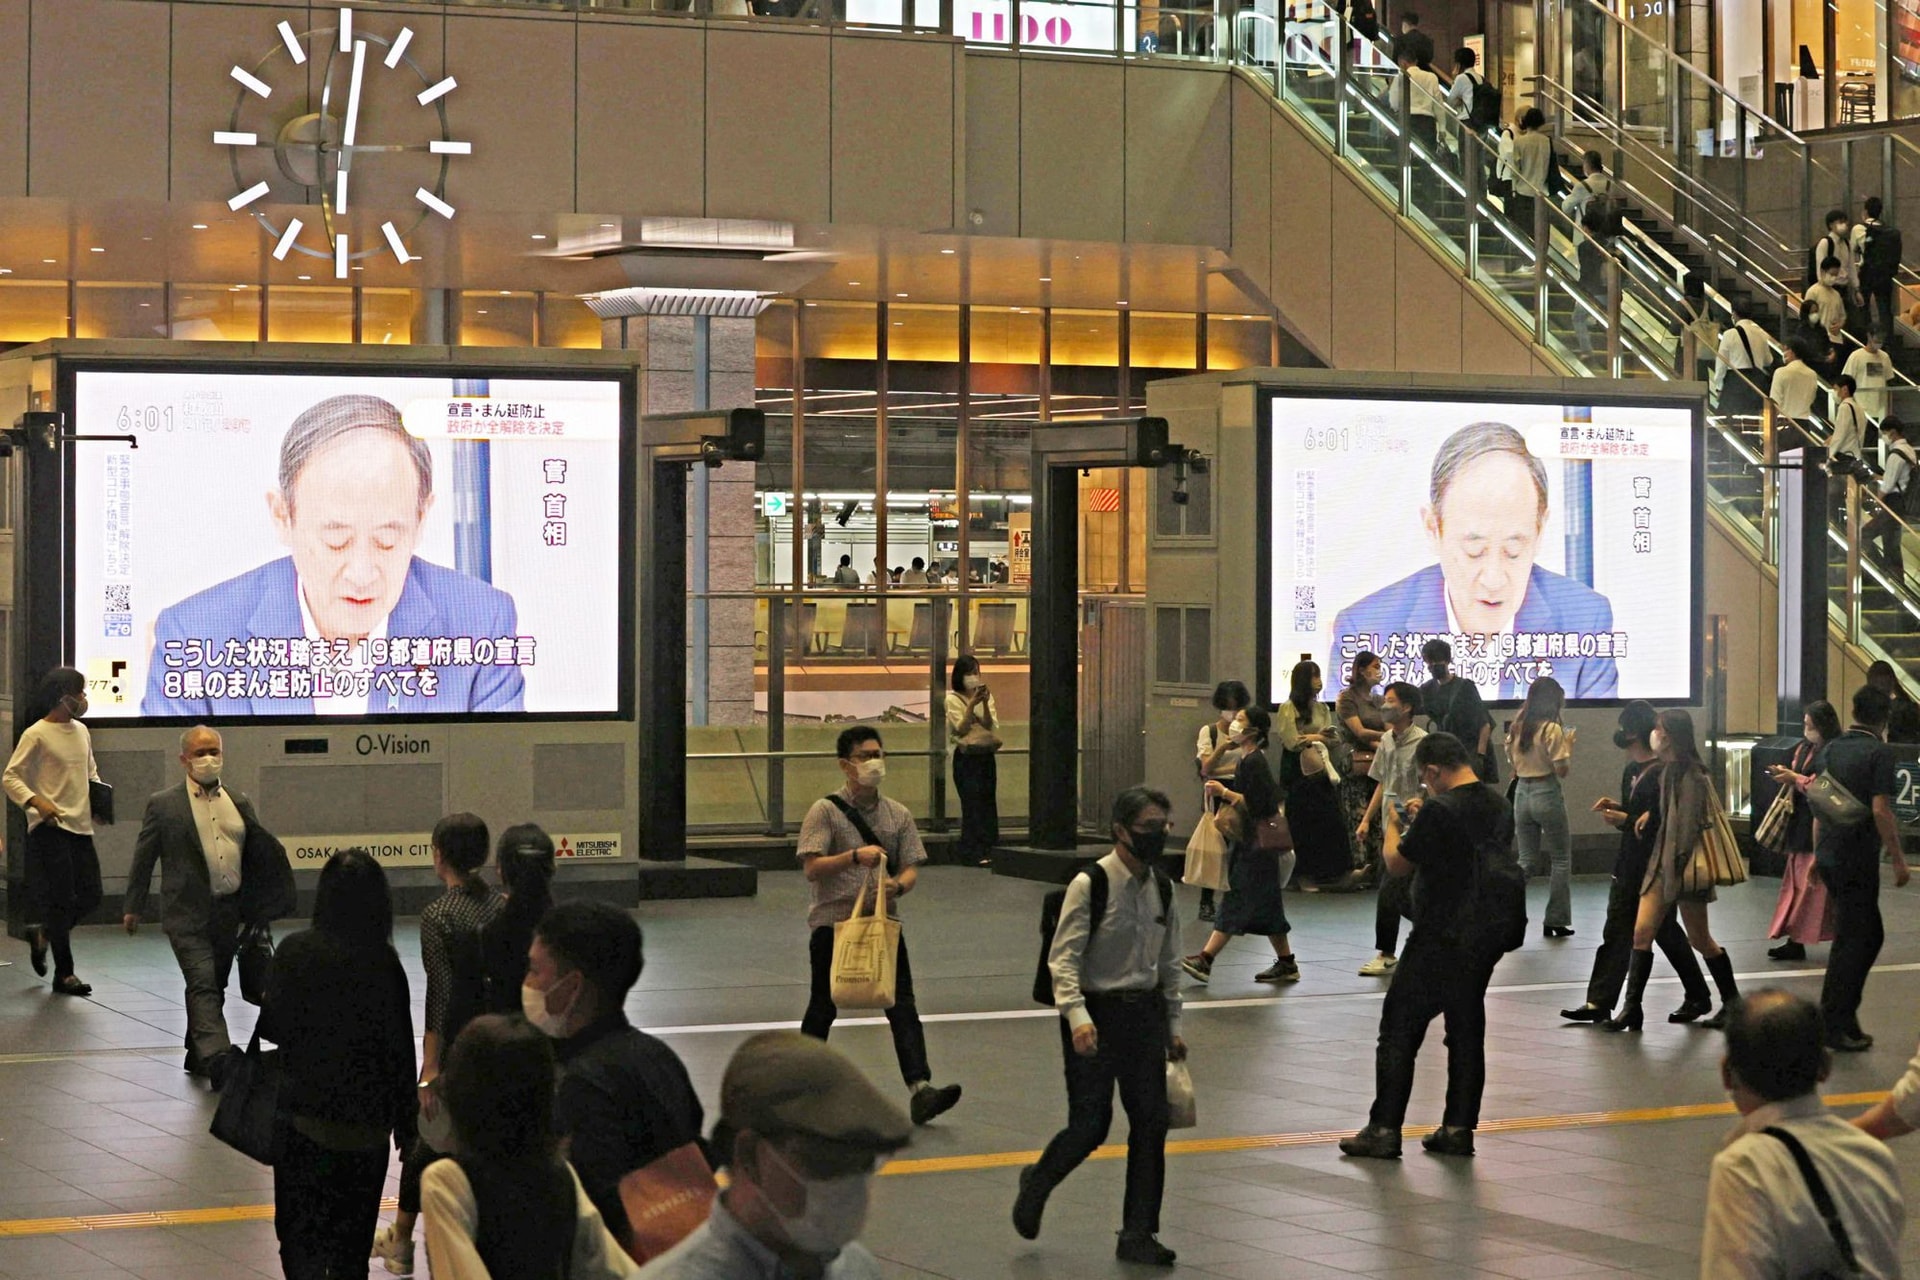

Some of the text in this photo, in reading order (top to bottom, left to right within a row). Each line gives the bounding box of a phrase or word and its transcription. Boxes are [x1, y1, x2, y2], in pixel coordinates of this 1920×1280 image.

[1142, 36, 1157, 54] 3F
[116, 405, 174, 432] 6:01
[447, 403, 546, 419] 宣言・まん延防止
[447, 420, 565, 436] 政府が全解除を決定
[1303, 426, 1349, 452] 6:01
[1560, 426, 1635, 441] 宣言・まん延防止
[1560, 442, 1649, 456] 政府が全解除を決定
[542, 493, 568, 546] 首相
[1633, 506, 1652, 553] 首相
[164, 635, 537, 668] こうした状況踏まえ 19都道府県の宣言
[1491, 631, 1628, 659] 19都道府県の宣言
[163, 669, 440, 699] 8県のまん延防止のすべてを
[356, 734, 430, 755] O-Vision
[1896, 769, 1920, 805] 2F
[354, 845, 402, 858] ATION
[409, 844, 436, 856] CIT
[576, 848, 611, 856] ELECTRIC
